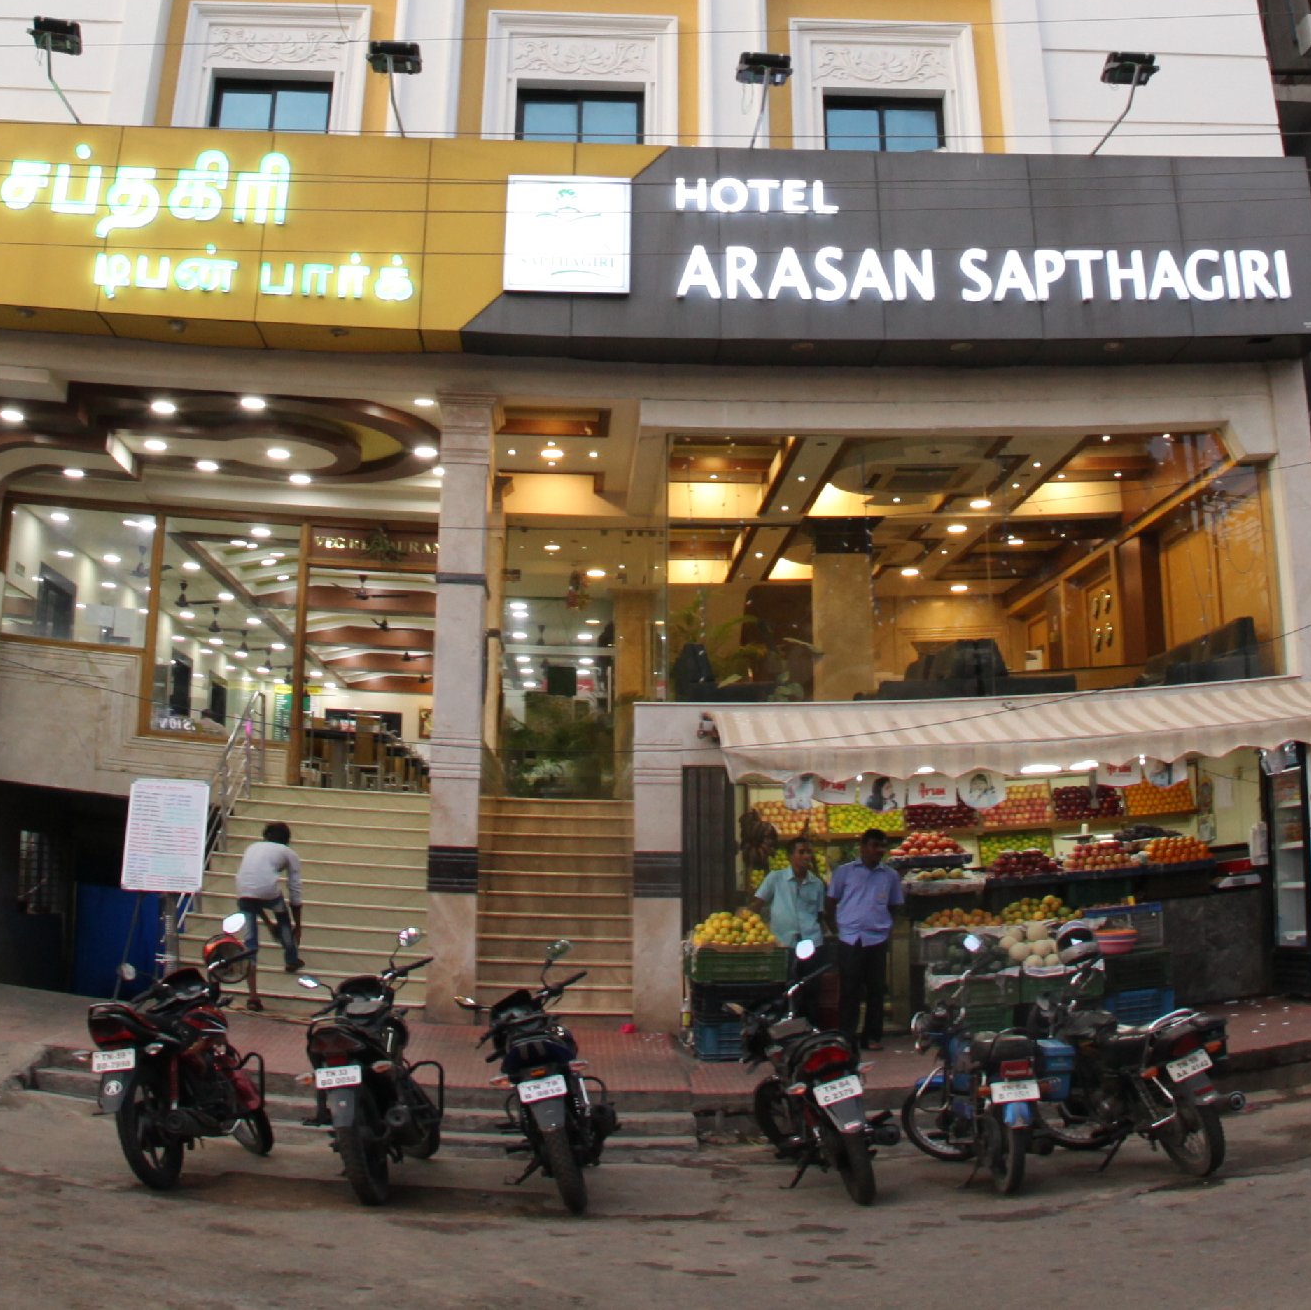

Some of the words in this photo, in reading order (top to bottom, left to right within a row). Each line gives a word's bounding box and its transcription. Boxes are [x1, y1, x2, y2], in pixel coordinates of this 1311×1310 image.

[0, 144, 291, 238] சப்தகிரி
[674, 176, 840, 215] HOTEL
[94, 243, 239, 299] டிபன்
[258, 252, 414, 301] பார்க்
[676, 244, 936, 302] ARASAN
[961, 246, 1292, 302] SAPTHAGIRI
